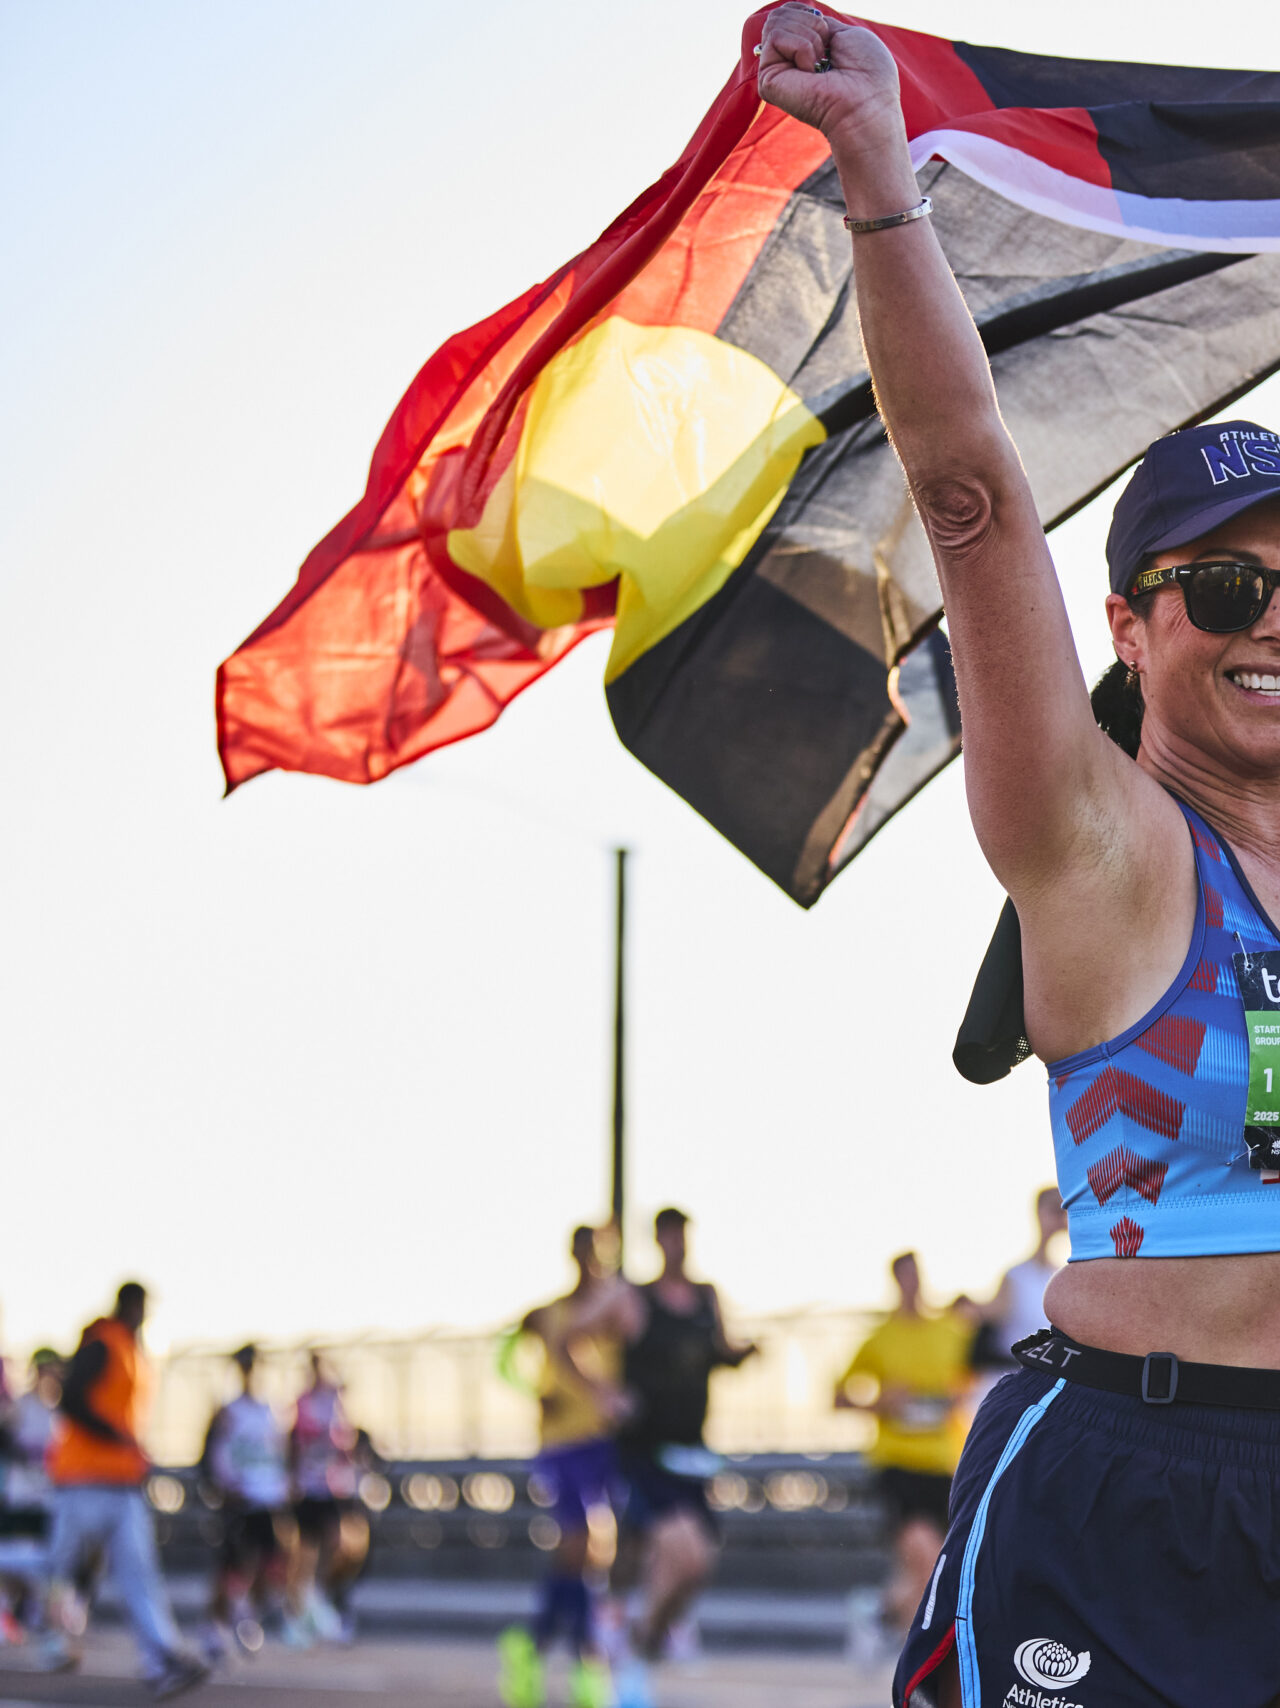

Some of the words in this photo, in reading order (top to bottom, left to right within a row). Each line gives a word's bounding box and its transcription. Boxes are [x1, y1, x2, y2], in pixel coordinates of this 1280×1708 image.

[1254, 1025, 1280, 1035] START
[1263, 1067, 1273, 1093] 1
[1253, 1111, 1280, 1122] 2025
